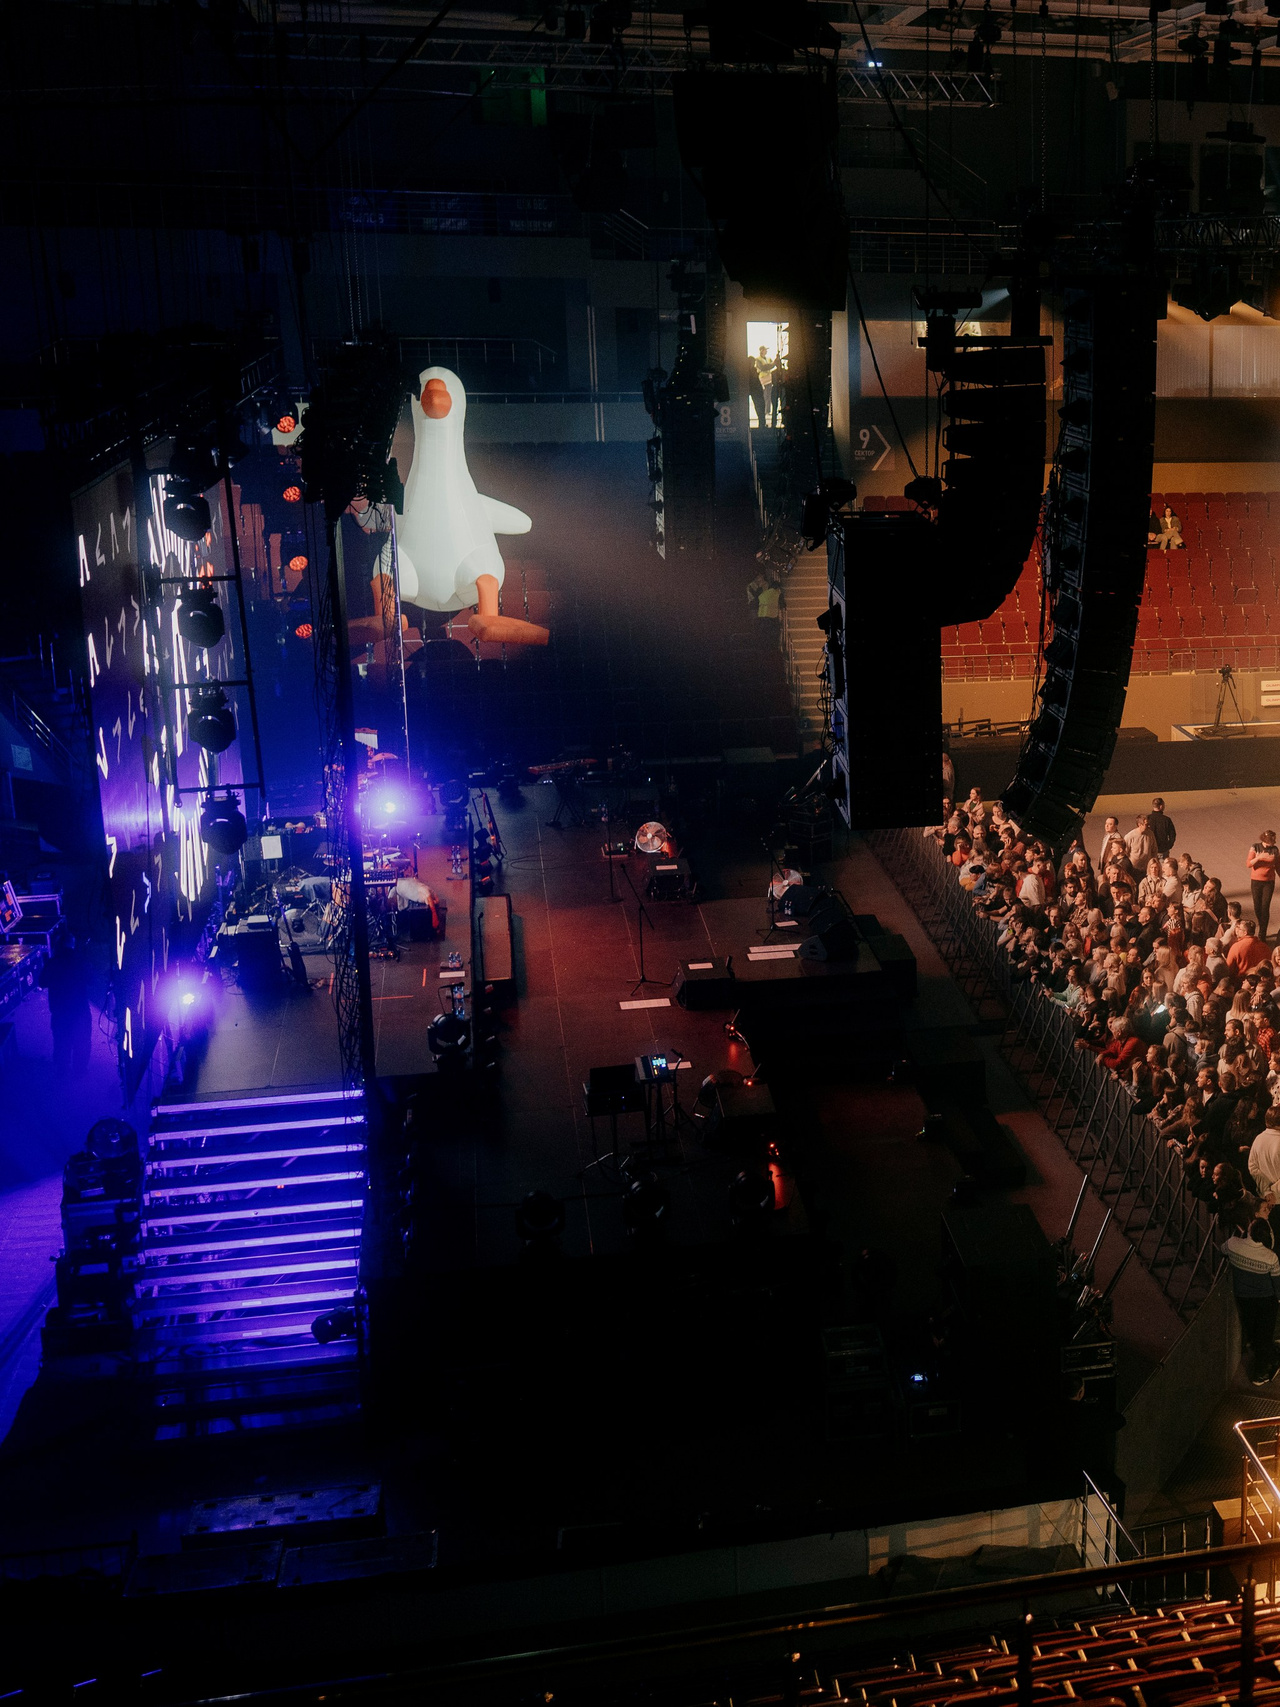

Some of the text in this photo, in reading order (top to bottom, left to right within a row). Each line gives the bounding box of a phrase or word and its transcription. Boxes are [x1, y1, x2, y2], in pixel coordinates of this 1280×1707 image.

[720, 406, 731, 426] 8
[859, 428, 871, 449] 9
[854, 449, 876, 457] СЕКТОР
